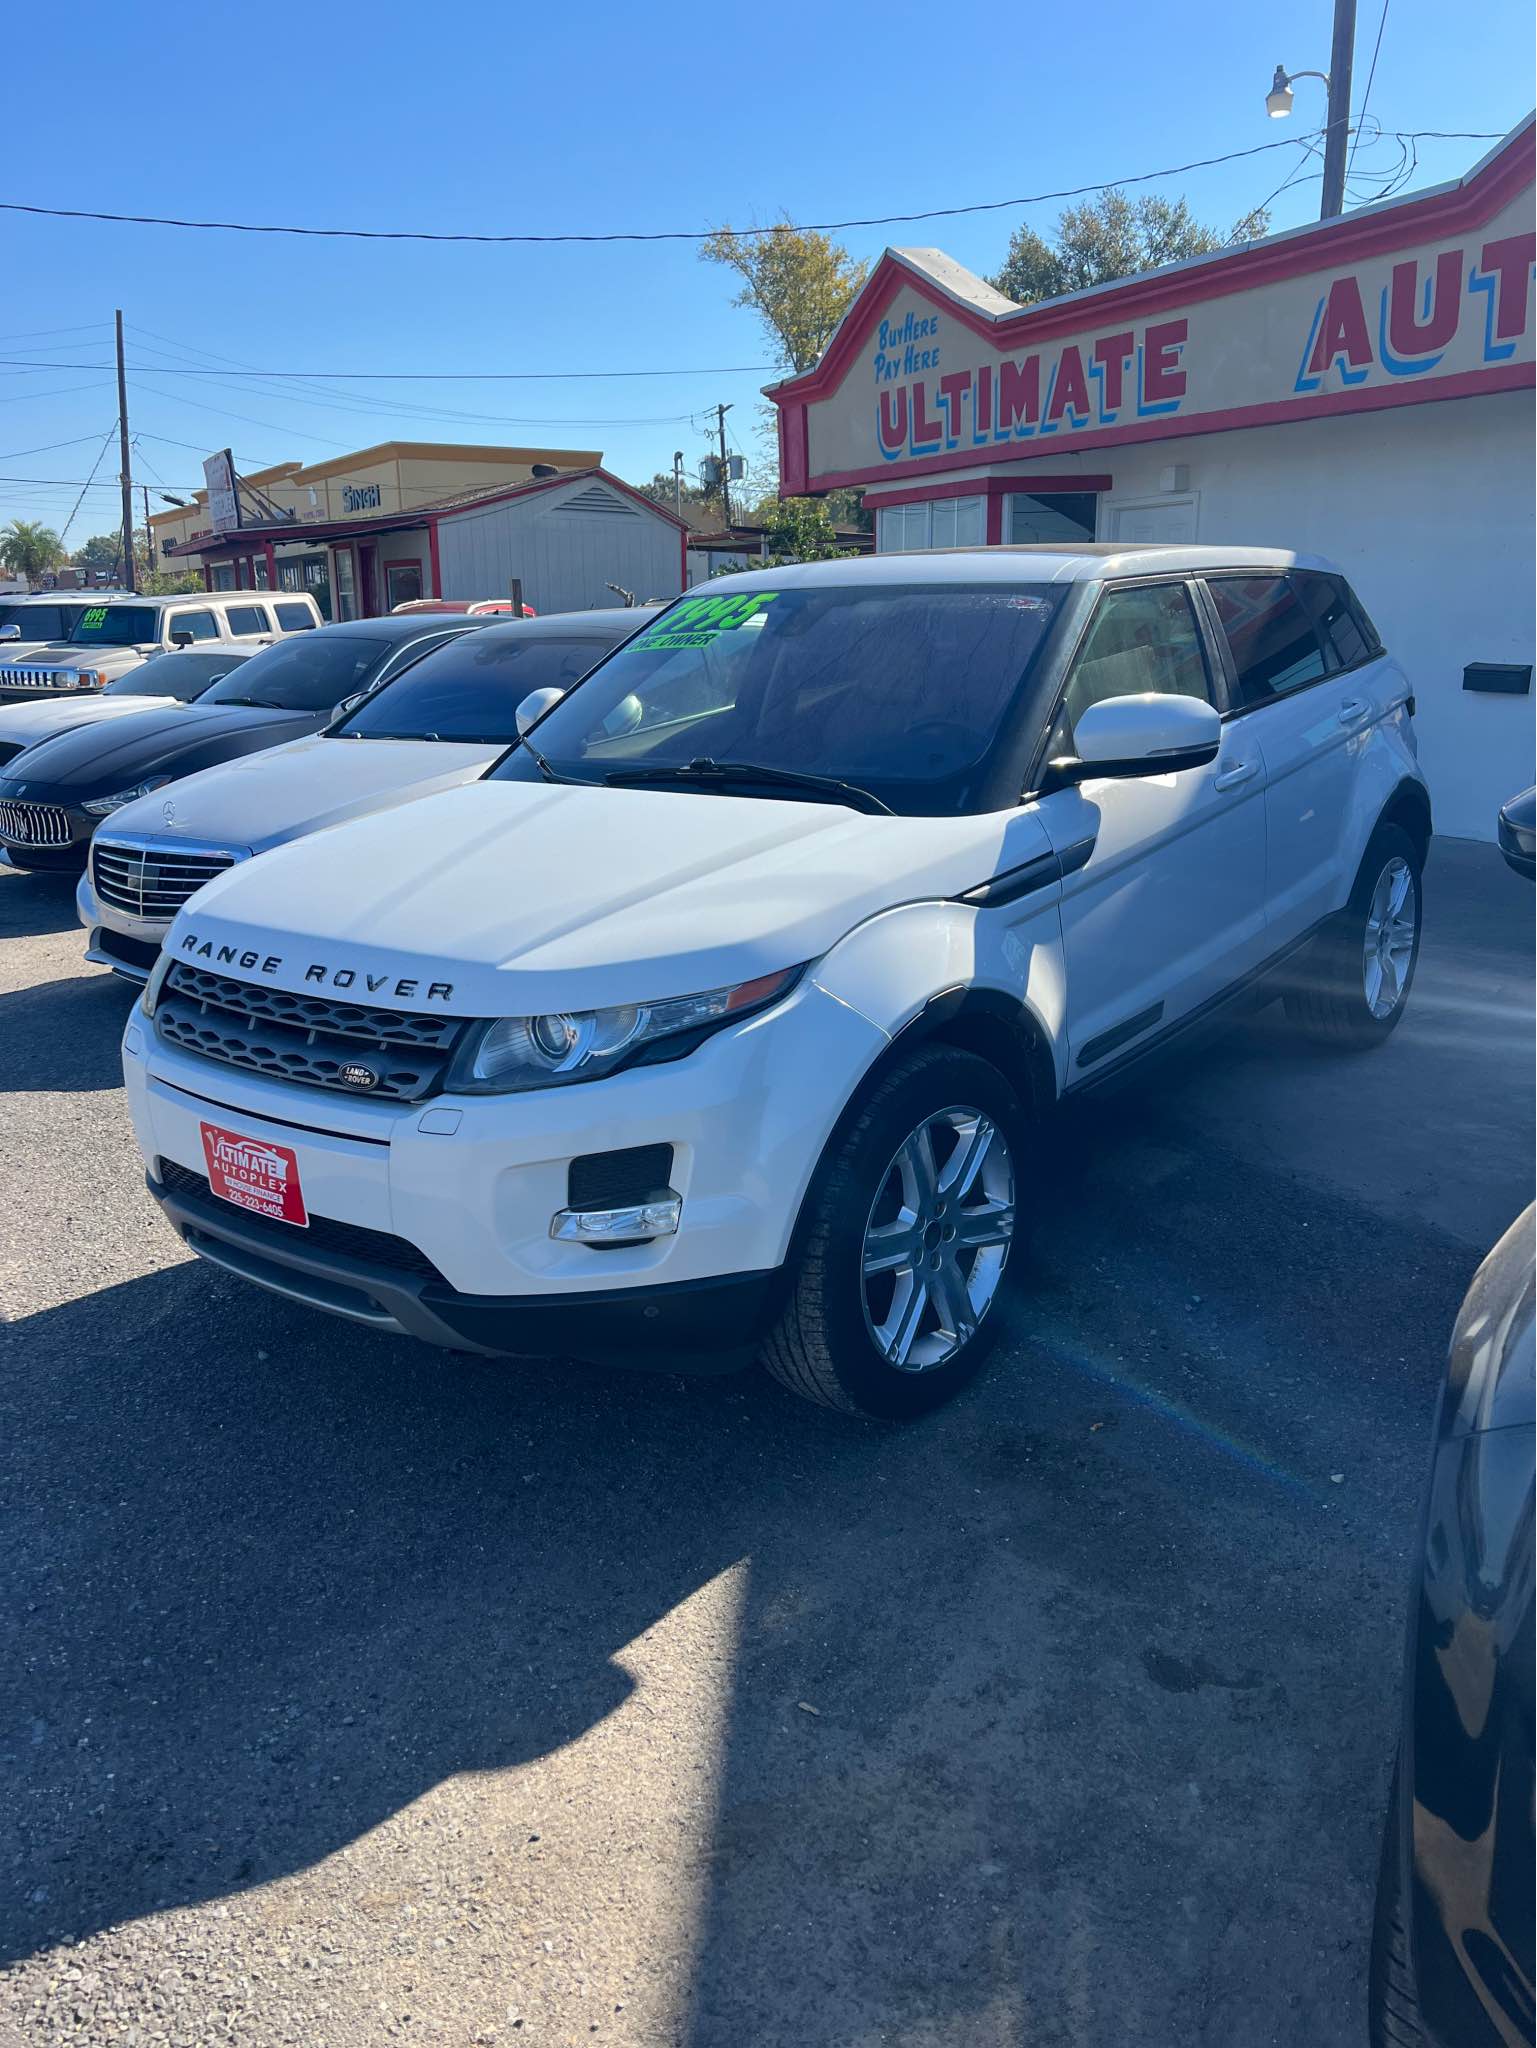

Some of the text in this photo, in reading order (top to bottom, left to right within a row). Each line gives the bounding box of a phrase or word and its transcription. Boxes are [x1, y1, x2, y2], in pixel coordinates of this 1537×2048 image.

[904, 344, 941, 375] HERE
[878, 319, 1188, 460] ULTIMATE
[84, 608, 109, 621] 6995
[659, 633, 715, 647] OWNER
[182, 934, 456, 1001] RANGE ROVER
[346, 1067, 365, 1076] LAND
[347, 1075, 371, 1085] ROVER
[206, 1132, 278, 1178] ULTIMATE
[213, 1160, 287, 1194] AUTOPLEX
[253, 1185, 281, 1203] FINANCE
